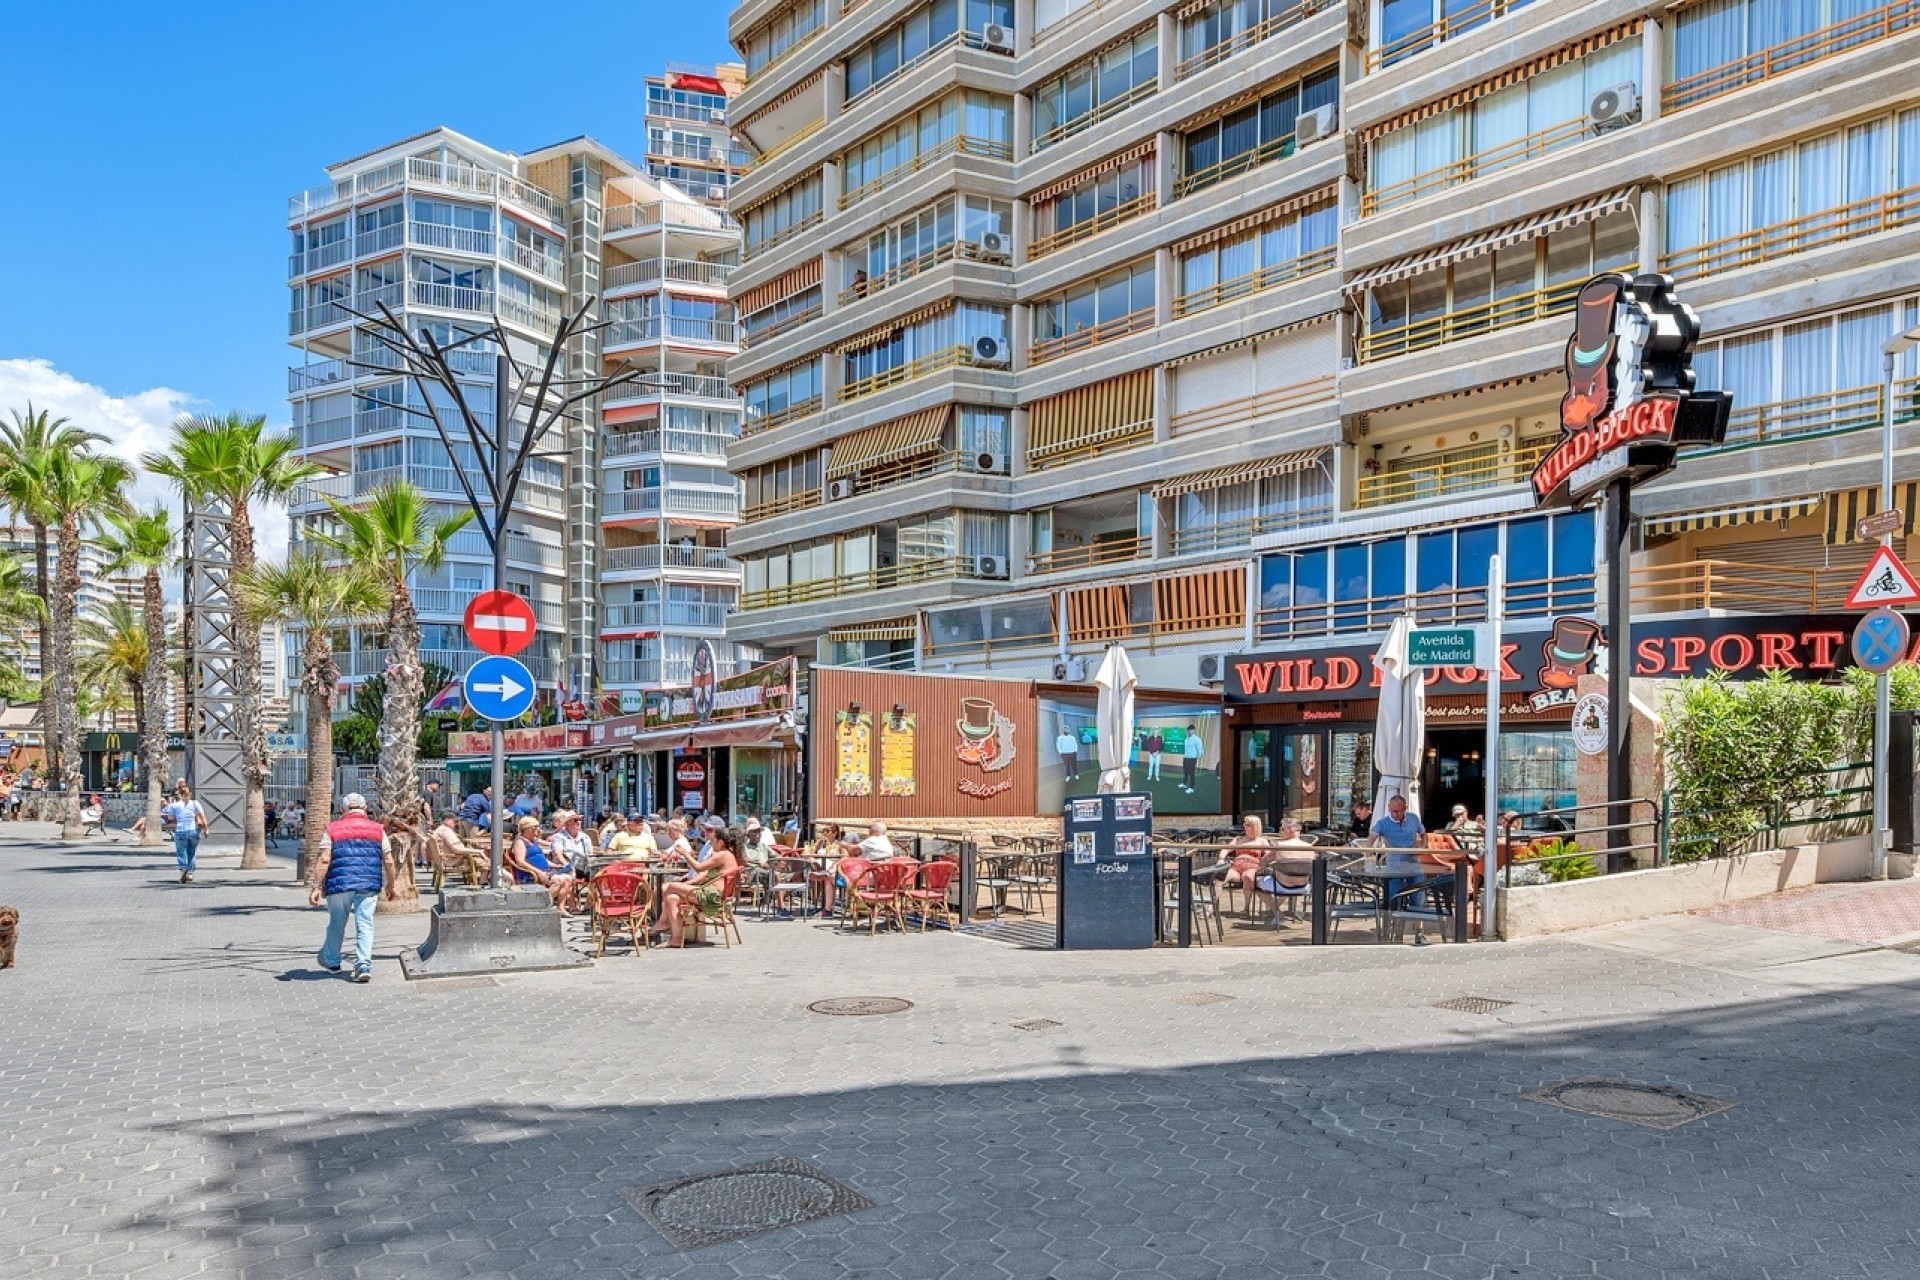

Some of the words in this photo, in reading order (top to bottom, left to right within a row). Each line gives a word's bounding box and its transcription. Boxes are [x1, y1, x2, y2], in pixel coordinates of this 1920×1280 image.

[1534, 431, 1591, 495] WILD
[1596, 399, 1673, 450] DUCK
[1418, 634, 1465, 646] Avenida
[1636, 631, 1845, 674] SPORT
[1411, 650, 1427, 661] de
[1429, 649, 1471, 661] Madrid
[1235, 656, 1360, 695] WILD
[1425, 706, 1447, 716] best
[1448, 705, 1470, 717] pub
